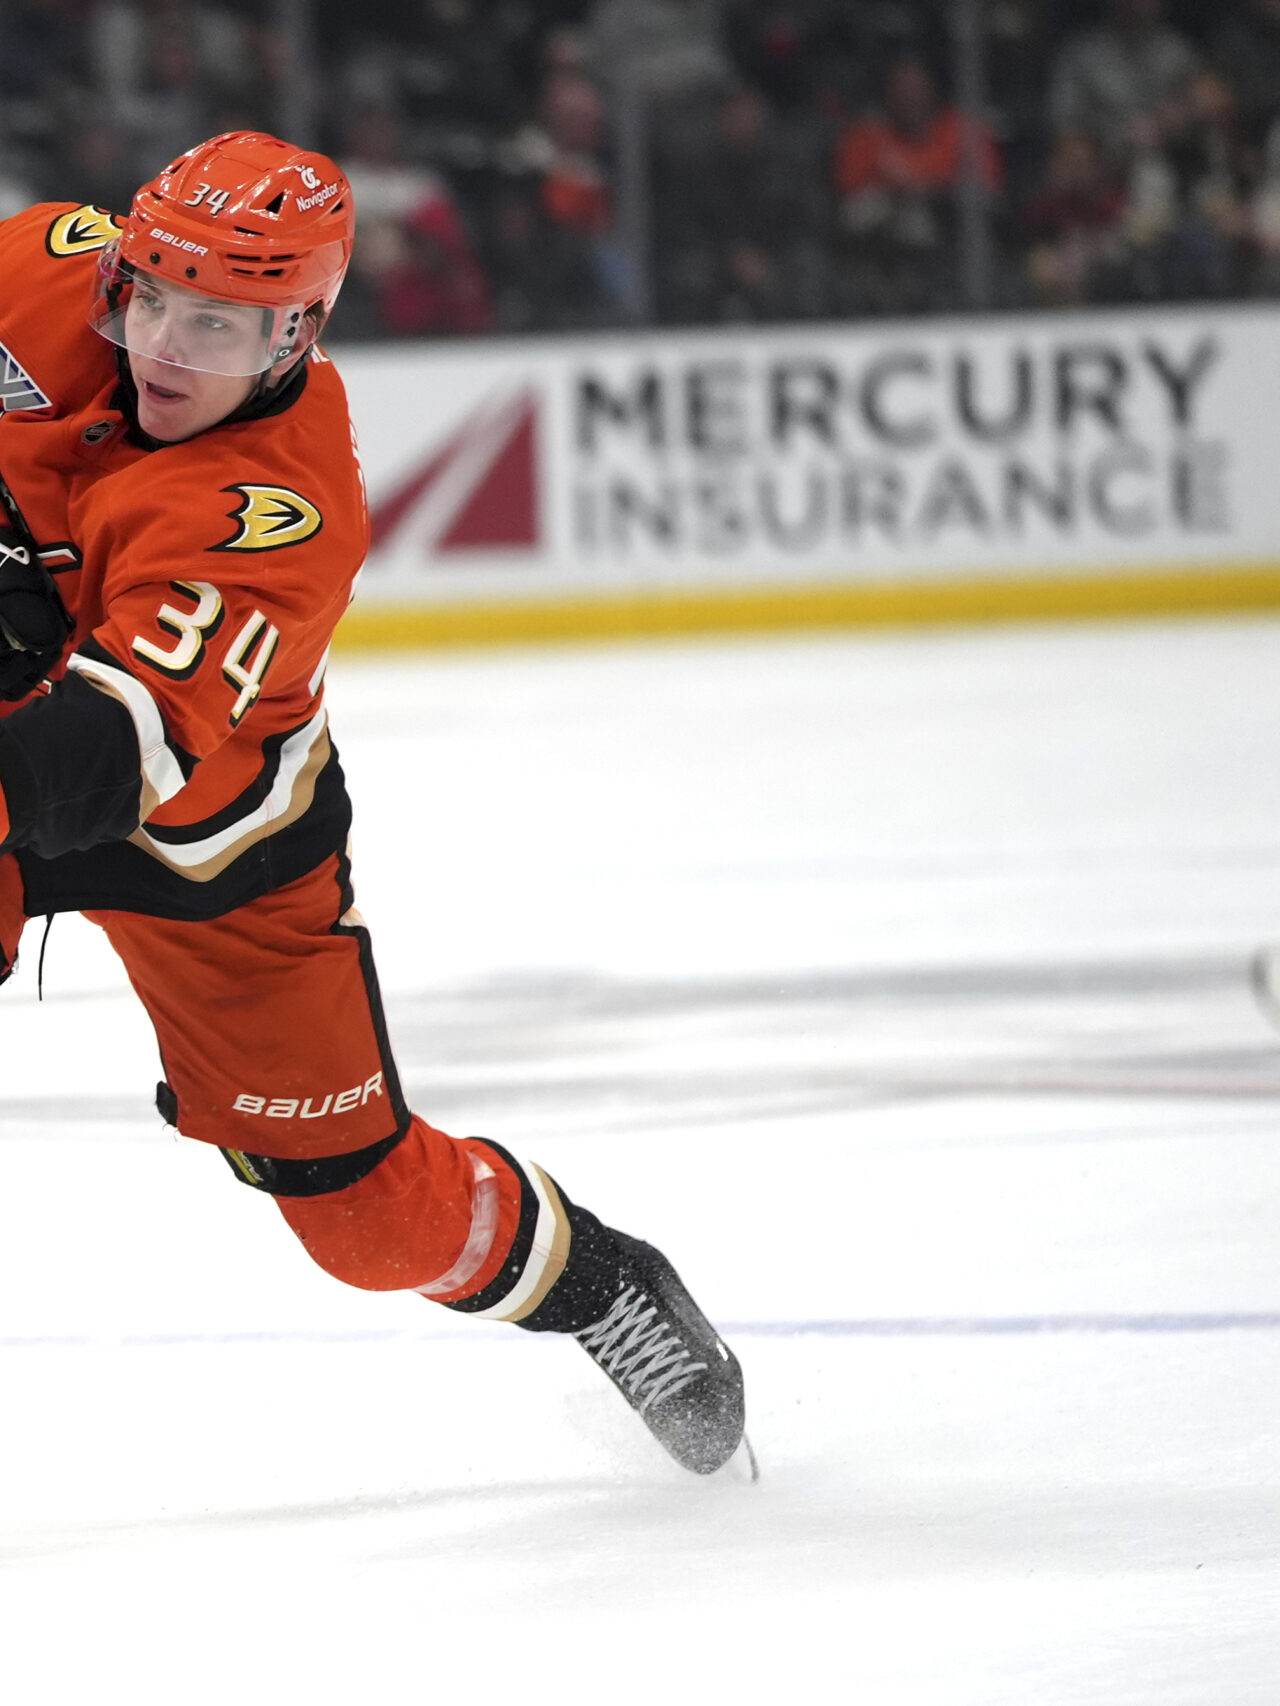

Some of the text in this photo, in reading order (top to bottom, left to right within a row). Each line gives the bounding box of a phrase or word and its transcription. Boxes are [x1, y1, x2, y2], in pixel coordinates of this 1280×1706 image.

[184, 182, 231, 216] 34
[295, 183, 338, 212] Navigator
[149, 228, 209, 256] BAUER
[573, 333, 1220, 456] MERCURY
[572, 438, 1231, 556] INSURANCE
[130, 580, 280, 728] 34
[232, 1070, 385, 1119] BAUER
